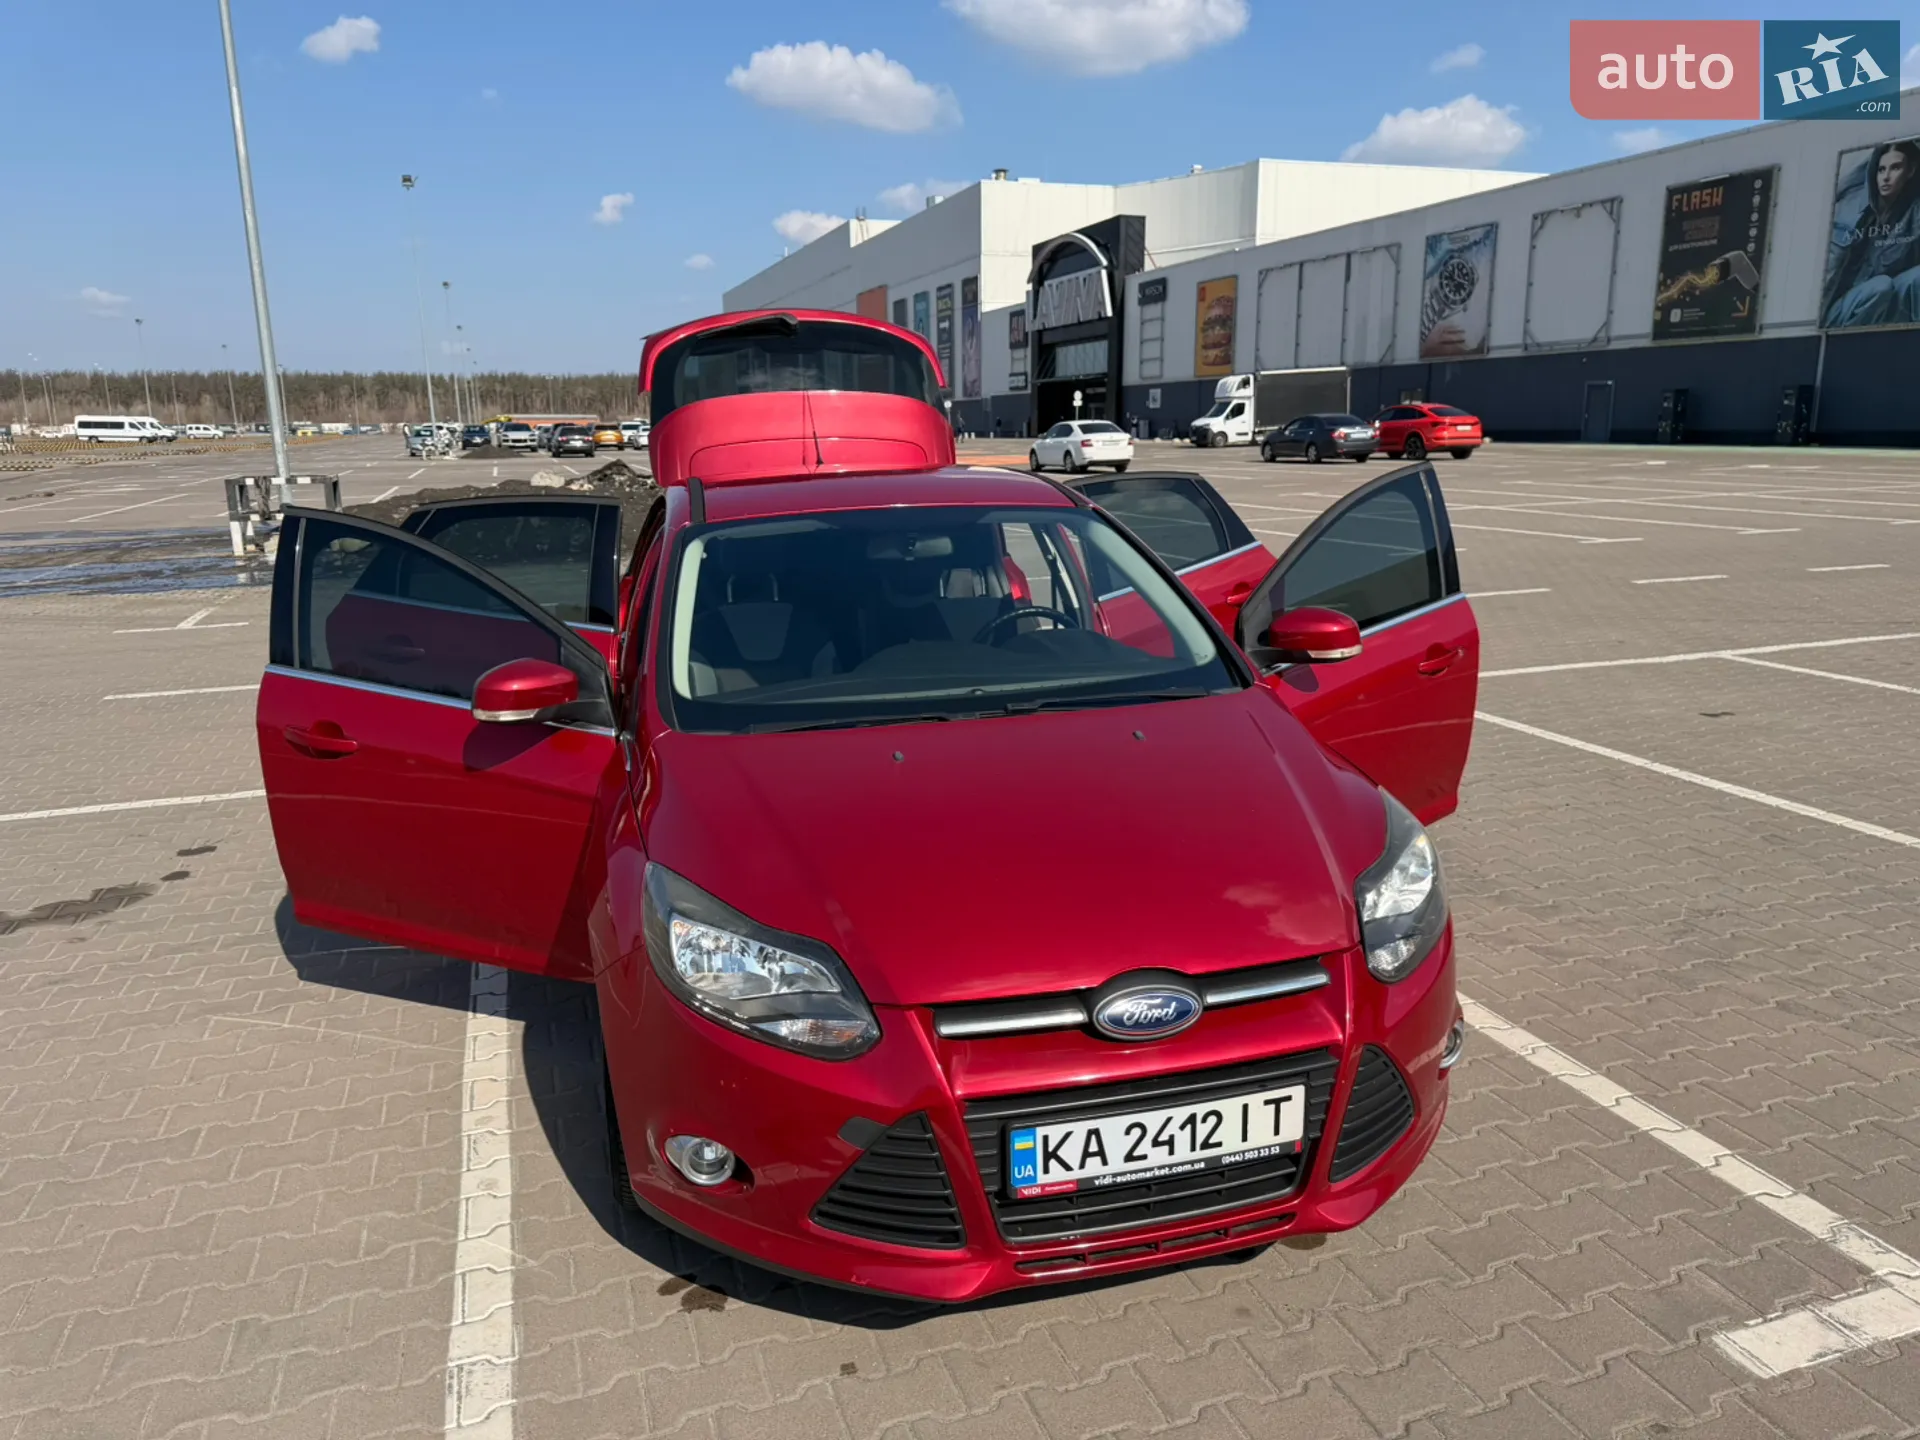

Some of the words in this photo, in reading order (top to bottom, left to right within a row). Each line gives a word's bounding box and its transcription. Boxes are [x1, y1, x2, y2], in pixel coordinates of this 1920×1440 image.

[1671, 186, 1724, 212] FLASH
[1026, 266, 1113, 332] LAVINA
[1123, 997, 1177, 1026] Ford
[1042, 1127, 1109, 1175] KA
[1123, 1109, 1224, 1163] 2412
[1241, 1094, 1293, 1143] IT
[1014, 1164, 1035, 1179] UA
[1094, 1161, 1206, 1186] vidi-automarket.com.ua
[1021, 1186, 1042, 1196] VIDI
